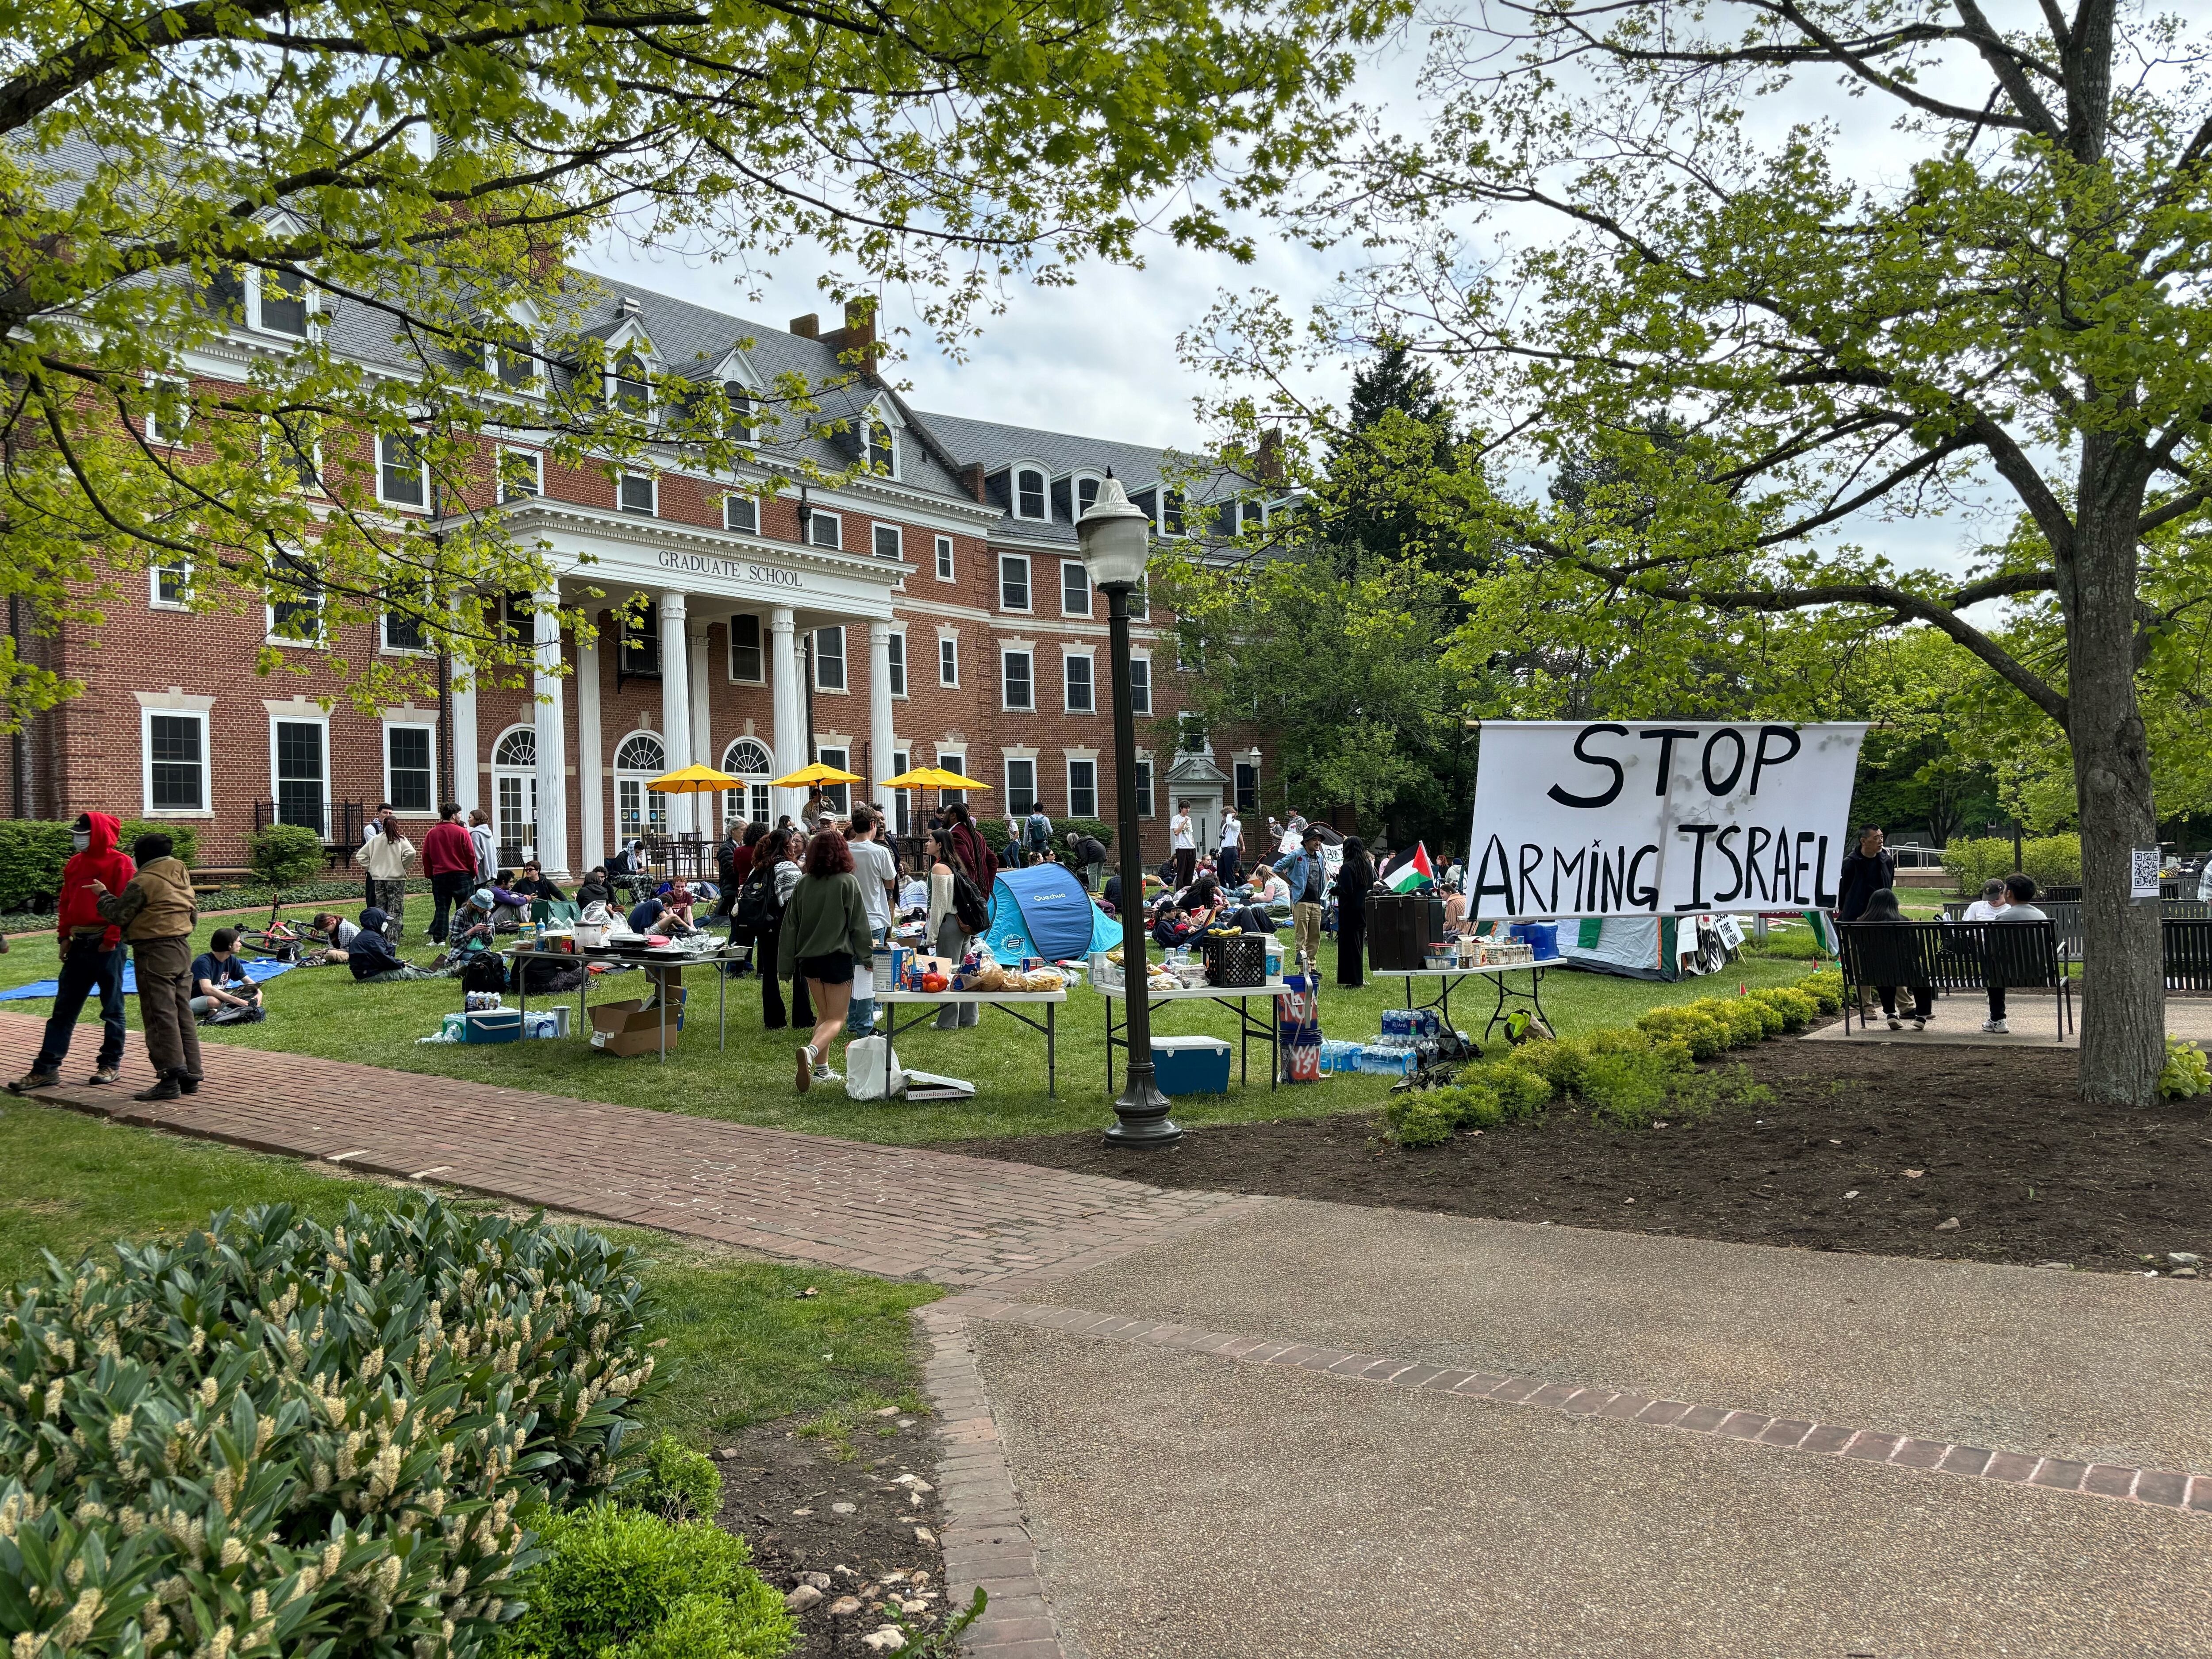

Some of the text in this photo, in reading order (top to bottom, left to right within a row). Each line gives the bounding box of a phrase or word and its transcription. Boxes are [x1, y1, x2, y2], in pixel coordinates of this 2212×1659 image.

[658, 551, 803, 587] GRADUATE SCHOOL
[1546, 723, 1801, 808] STOP
[1469, 823, 1840, 921] ARMING ISRAEL
[1034, 893, 1066, 902] Quechua
[1720, 922, 1732, 936] FIRE
[1727, 932, 1739, 947] NOW
